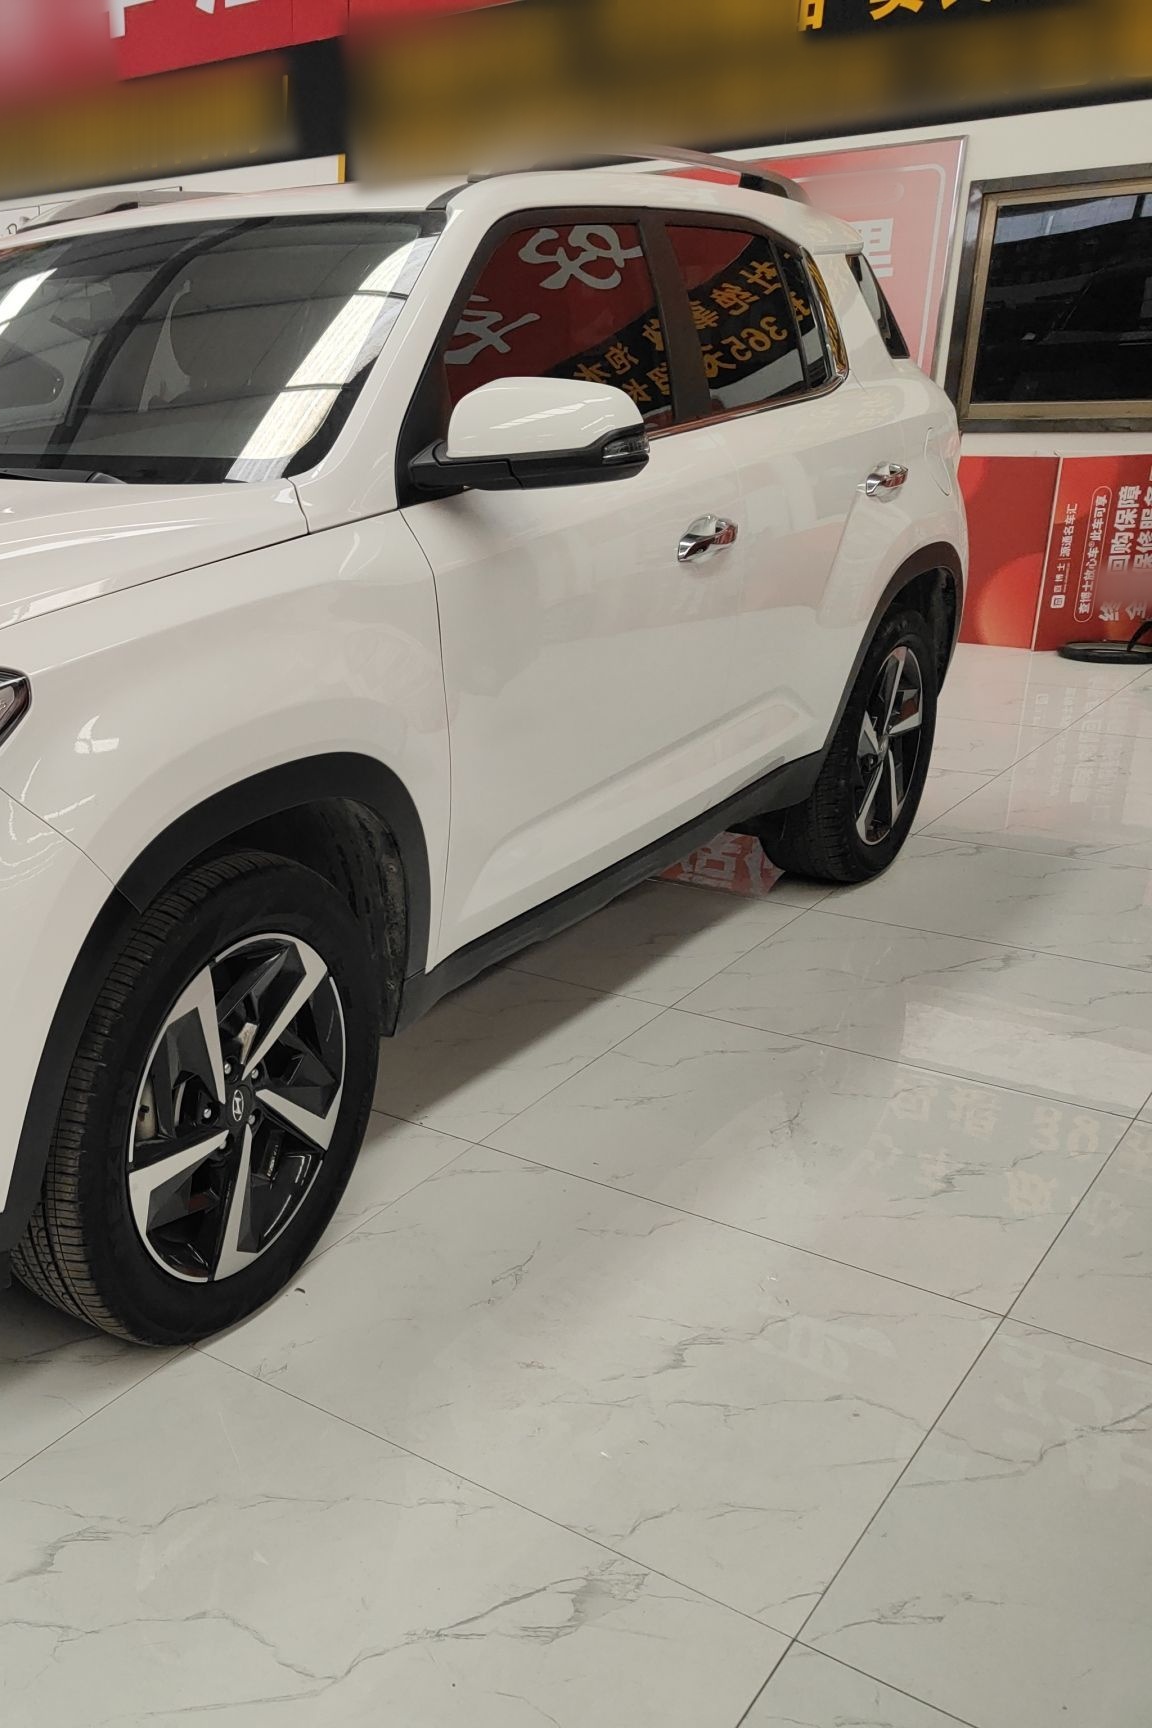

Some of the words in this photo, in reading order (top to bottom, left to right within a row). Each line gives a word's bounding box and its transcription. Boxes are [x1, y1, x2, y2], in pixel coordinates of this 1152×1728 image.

[1059, 503, 1078, 557] 源通名车汇
[1098, 485, 1142, 621] 终回购保障
